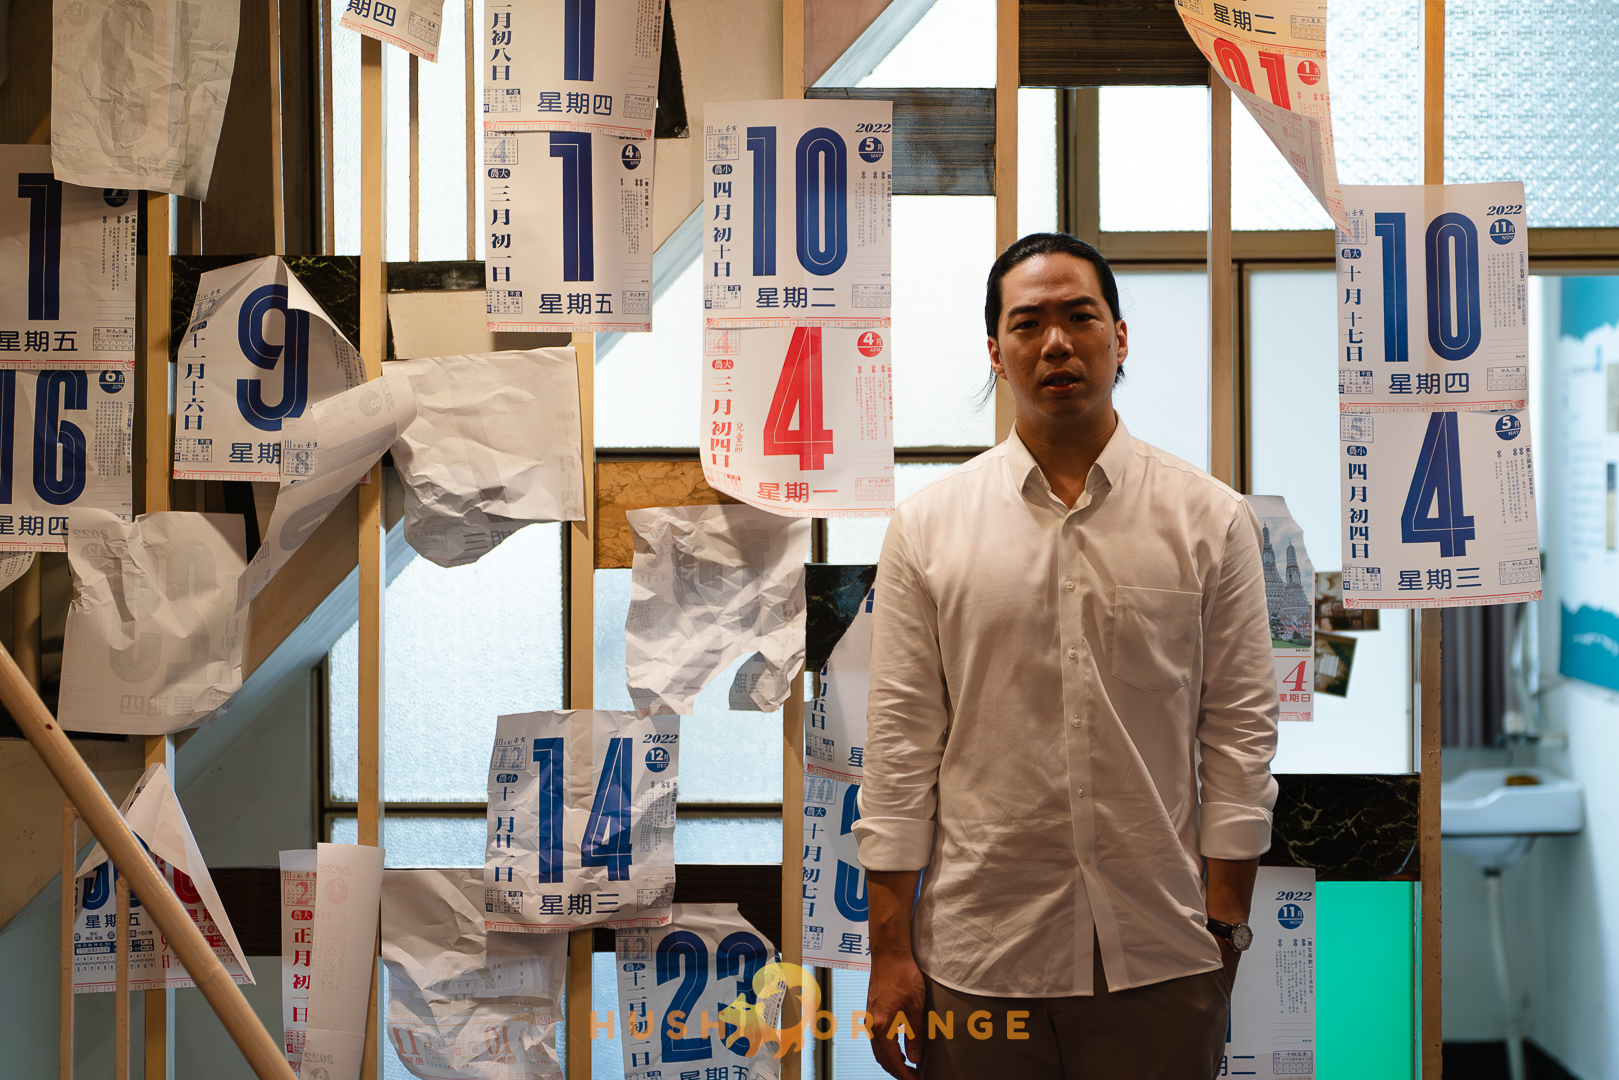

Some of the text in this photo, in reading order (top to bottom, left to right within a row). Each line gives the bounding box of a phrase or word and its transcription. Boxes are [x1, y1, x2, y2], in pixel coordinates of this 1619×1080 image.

[1213, 3, 1276, 34] 星期二
[537, 92, 613, 116] 星期四
[855, 123, 891, 133] 2022
[18, 173, 62, 320] 1
[489, 186, 512, 282] 三月初一日
[550, 132, 594, 282] 1
[712, 181, 732, 277] 四月初十日
[747, 126, 847, 276] 10
[1486, 205, 1522, 216] 2022
[539, 293, 613, 314] 星期五
[756, 287, 835, 308] 星期二
[1343, 265, 1364, 361] 十月十七日
[1375, 212, 1481, 362] 10
[0, 330, 78, 352] 星期五
[183, 333, 206, 431] 十一月十六日
[236, 284, 310, 432] 9
[1389, 373, 1469, 394] 星期四
[710, 376, 733, 467] 三月初四日
[764, 327, 833, 471] 4
[229, 442, 281, 464] 星期
[757, 482, 838, 502] 星期一
[1401, 411, 1475, 558] 4
[1349, 463, 1369, 558] 四月初四日
[1398, 567, 1482, 590] 星期三
[1279, 694, 1310, 702] 星期日
[1282, 661, 1307, 691] 4
[642, 734, 679, 744] 2022
[533, 738, 633, 883] 14
[539, 894, 621, 915] 星期三
[803, 823, 824, 917] 十月初七日
[1275, 891, 1313, 901] 2022
[291, 927, 312, 1023] 正月初一日
[656, 931, 768, 1063] 23
